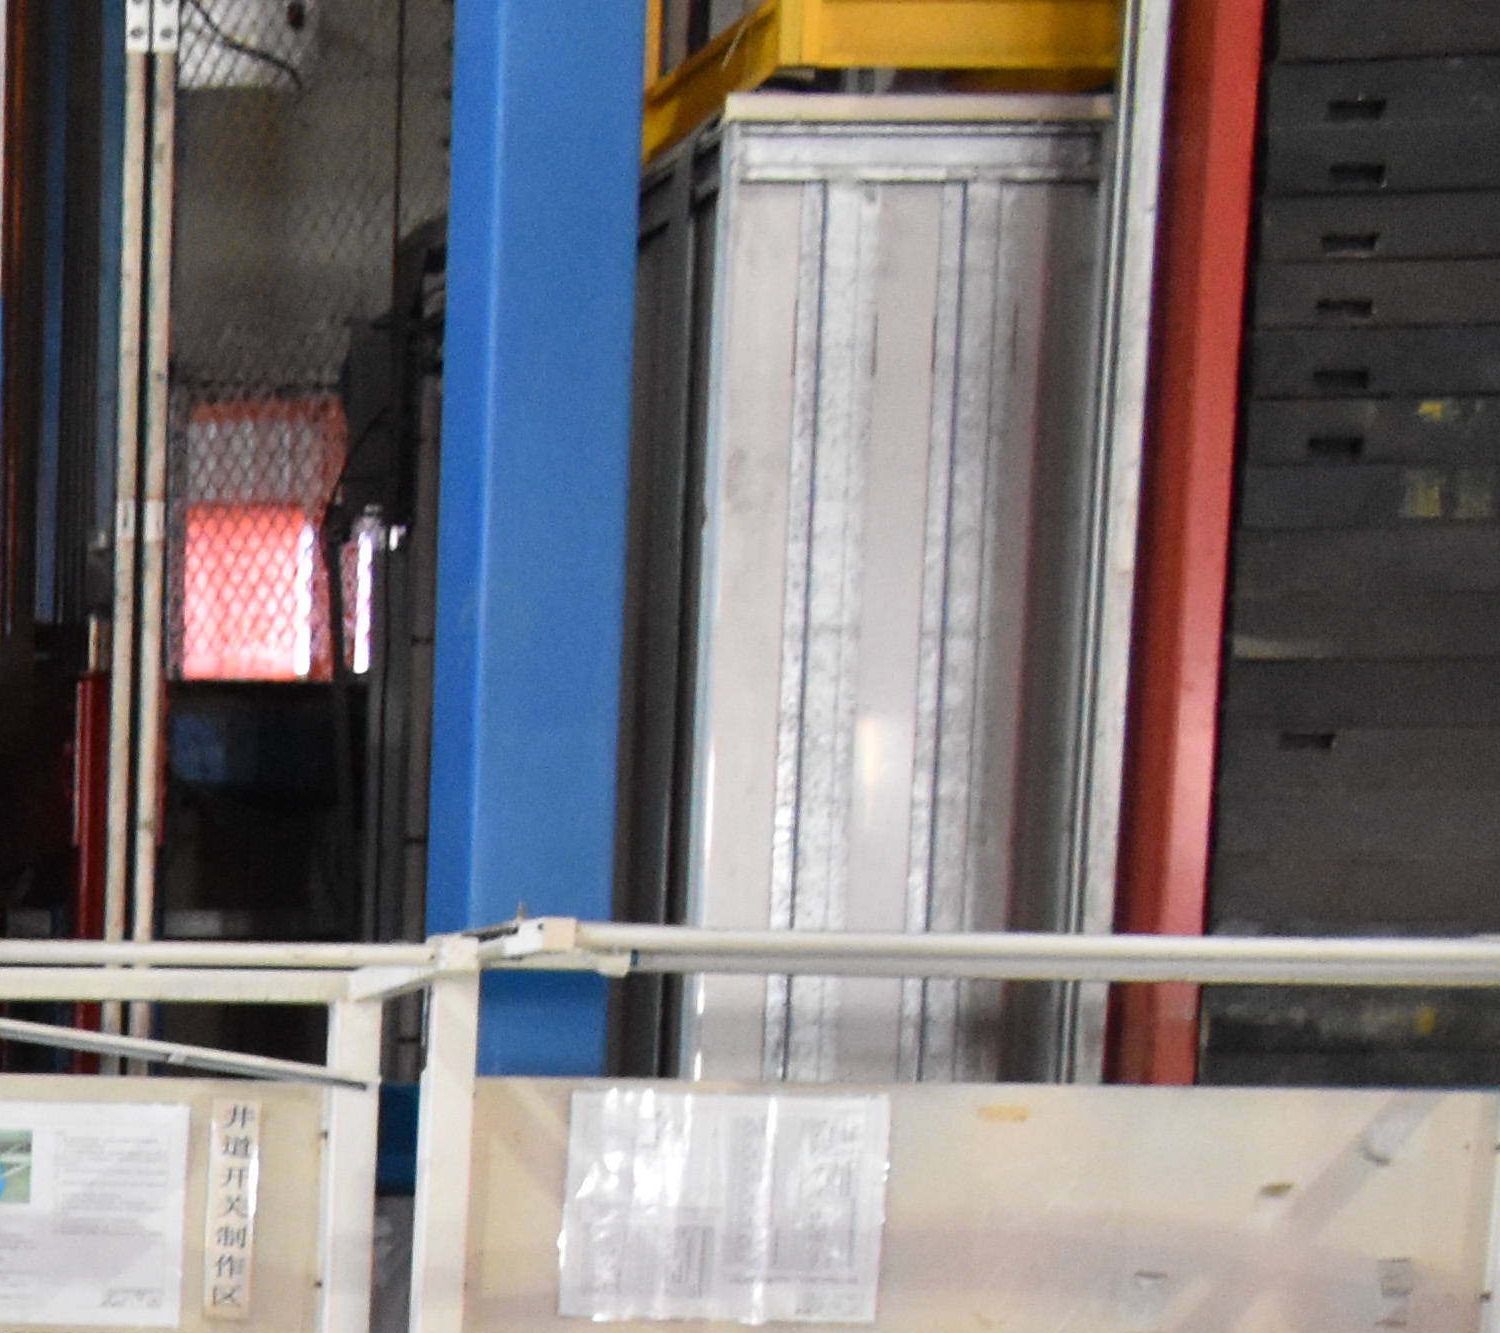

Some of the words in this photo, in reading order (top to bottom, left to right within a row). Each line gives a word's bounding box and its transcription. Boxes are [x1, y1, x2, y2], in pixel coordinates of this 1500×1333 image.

[212, 1103, 256, 1307] 井道开关制作区
